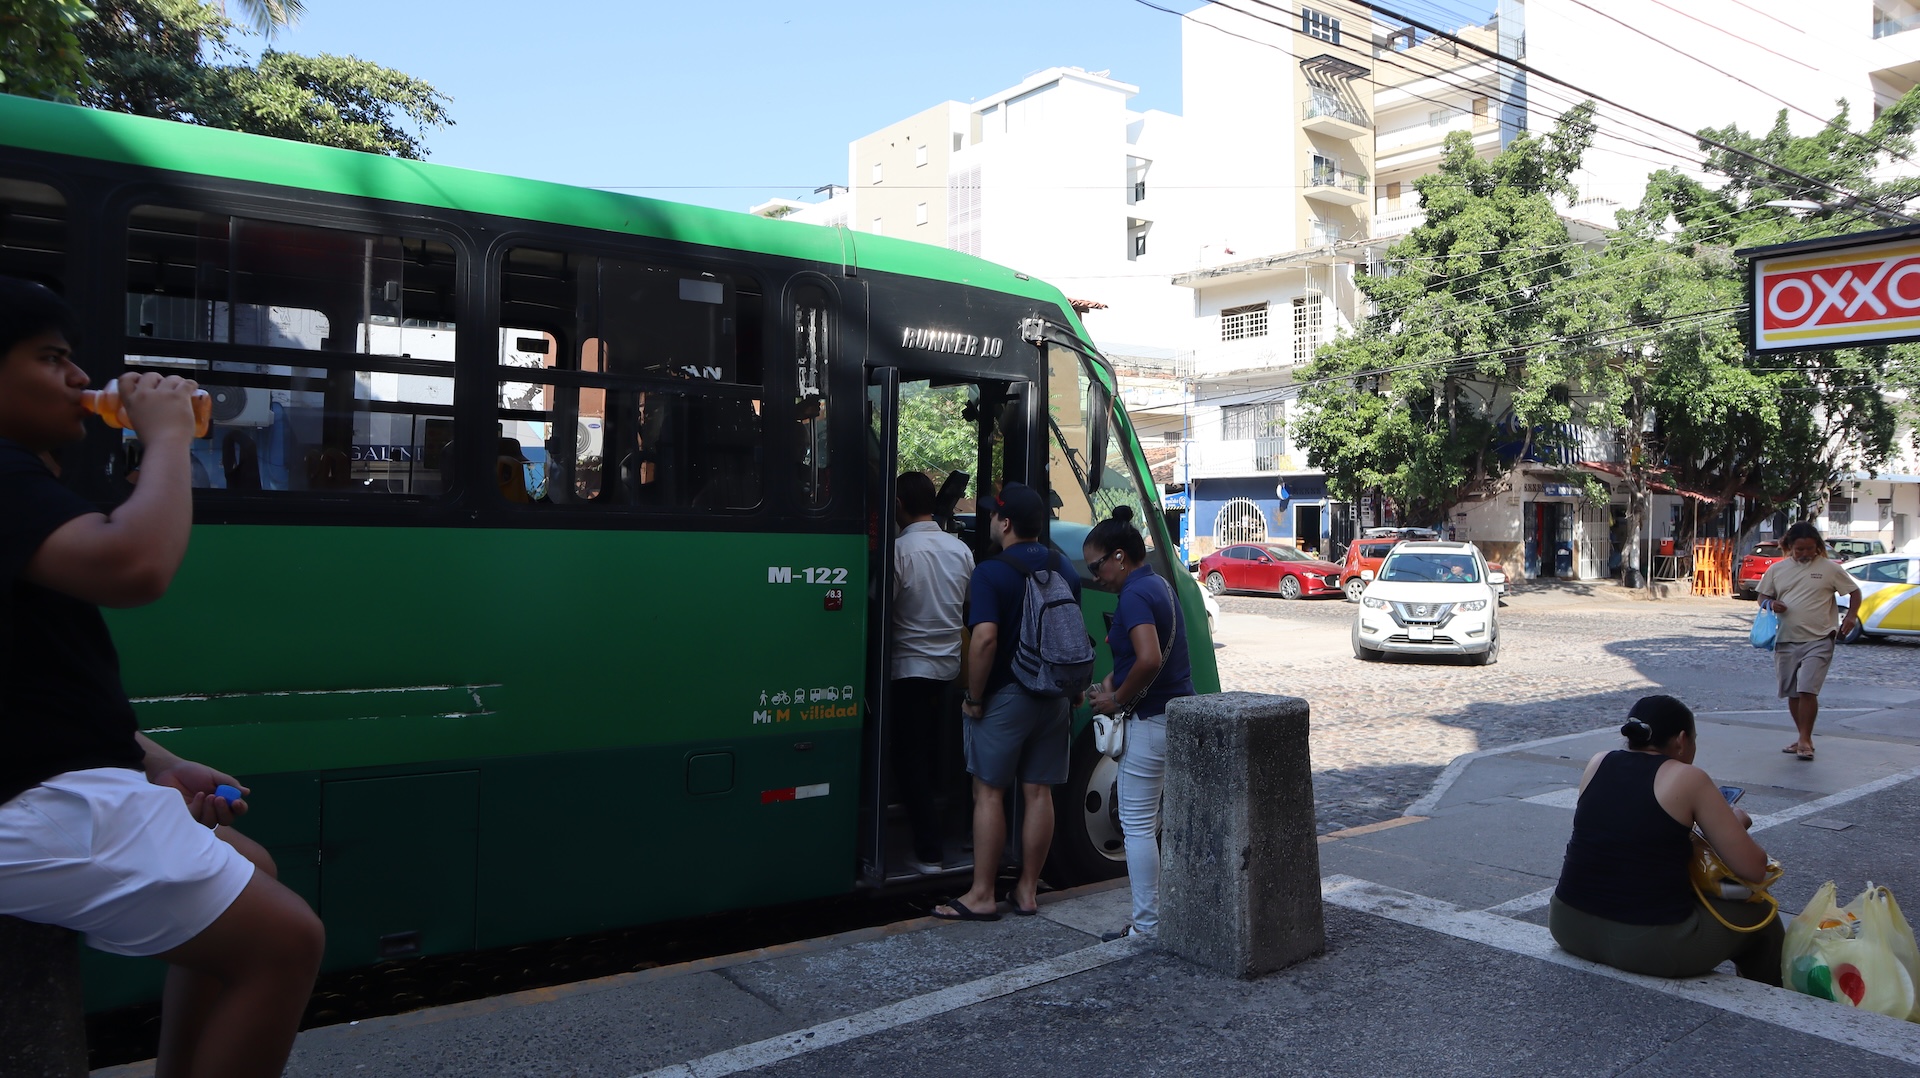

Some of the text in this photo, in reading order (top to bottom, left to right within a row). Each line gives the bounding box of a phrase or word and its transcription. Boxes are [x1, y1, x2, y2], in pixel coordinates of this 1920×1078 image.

[1768, 262, 1920, 327] OXXO
[901, 327, 1004, 358] RUNNER 10
[768, 567, 848, 584] M-122
[753, 710, 772, 724] Mi
